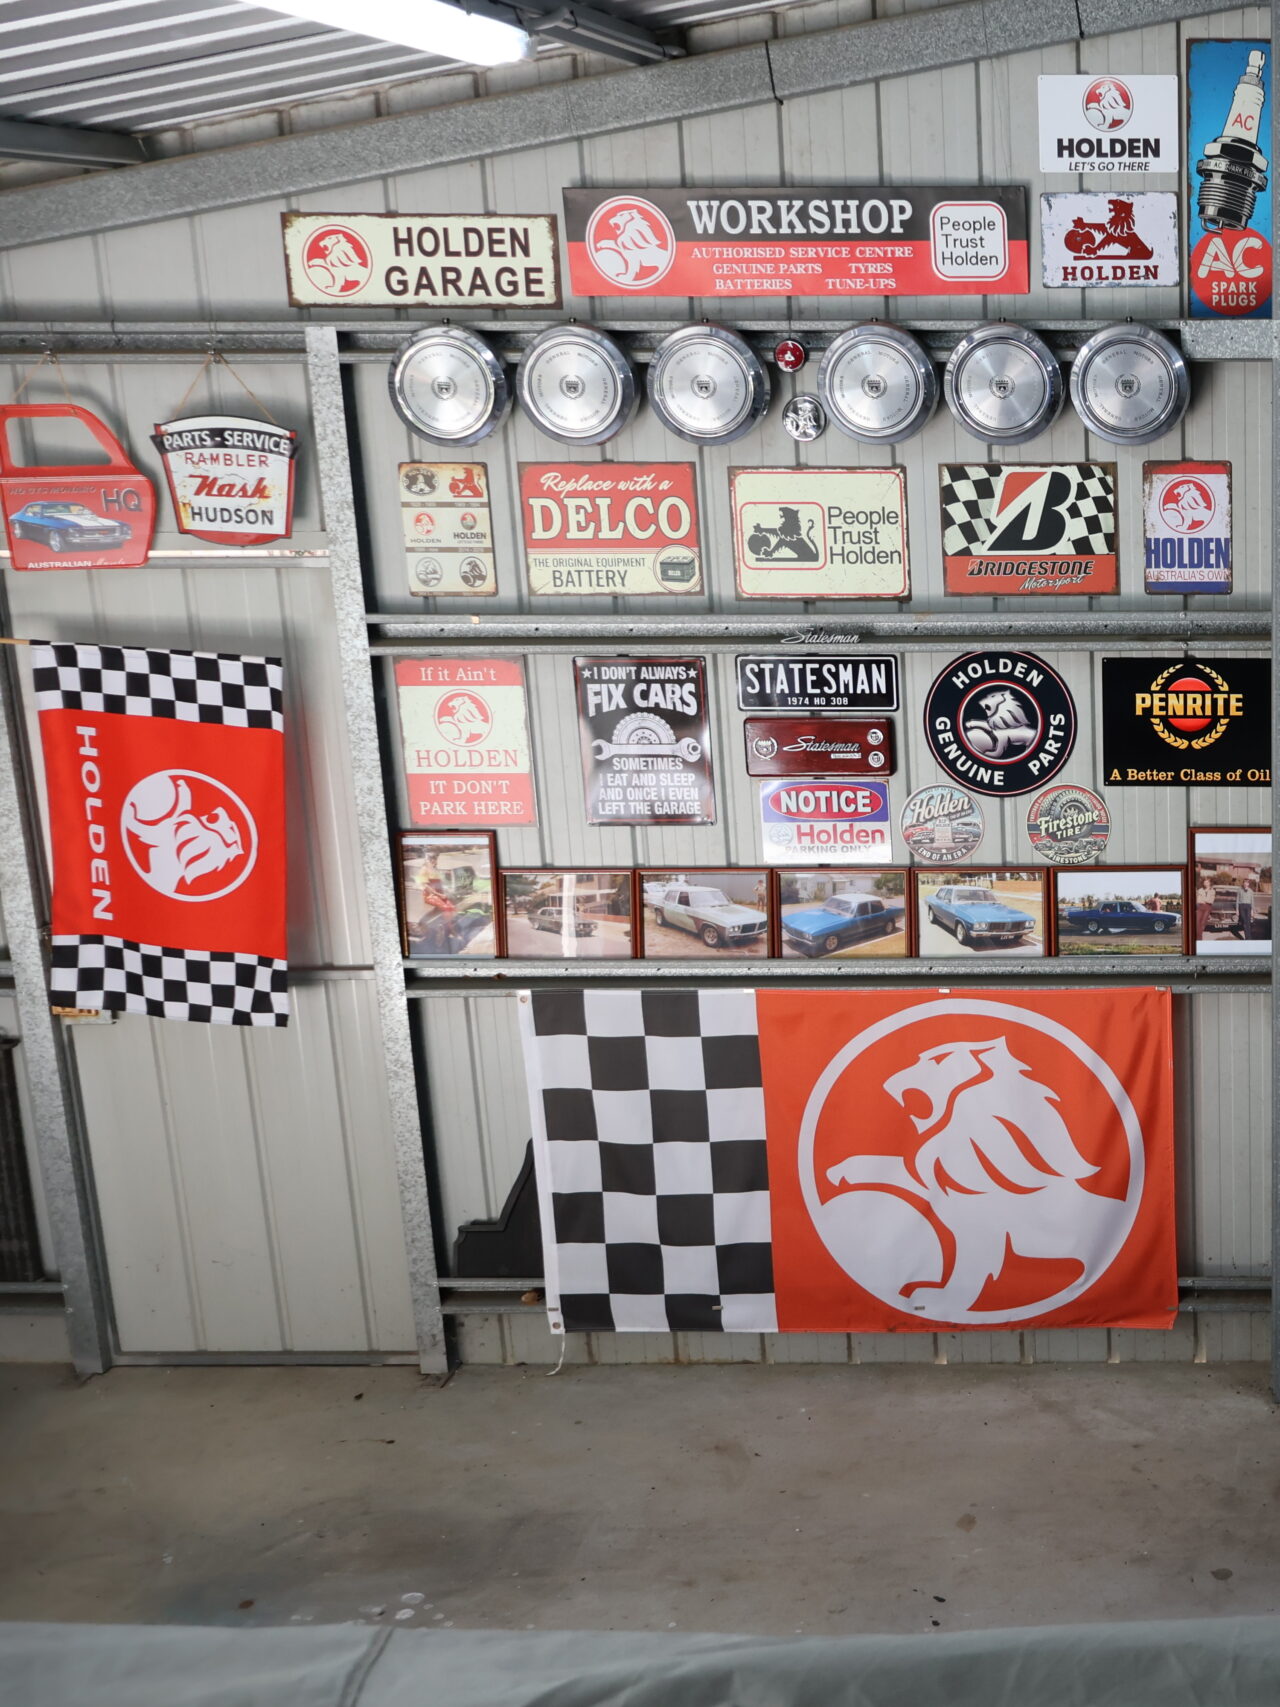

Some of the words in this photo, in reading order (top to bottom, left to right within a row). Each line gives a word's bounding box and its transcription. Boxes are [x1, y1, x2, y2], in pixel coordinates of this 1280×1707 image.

[1057, 138, 1160, 158] HOLDEN
[1069, 162, 1095, 171] LET'S
[1098, 162, 1114, 171] GO
[1117, 162, 1150, 171] THERE
[687, 199, 913, 234] WORKSHOP
[940, 216, 996, 234] People
[393, 226, 530, 257] HOLDEN
[941, 234, 985, 248] Trust
[692, 247, 785, 258] AUTHORISED
[789, 247, 850, 258] SERVICE
[855, 247, 913, 258] CENTRE
[941, 251, 999, 266] Holden
[1198, 237, 1264, 278] AC
[713, 264, 775, 274] GENUINE
[779, 264, 822, 274] PARTS
[849, 263, 893, 274] TYRES
[1062, 265, 1159, 281] HOLDEN
[385, 266, 545, 297] GARAGE
[715, 279, 792, 290] BATTERIES
[826, 278, 896, 289] TUNE-UPS
[1212, 281, 1257, 293] SPARK
[1212, 294, 1257, 306] PLUGS
[162, 431, 211, 451] PARTS
[225, 431, 290, 453] SERVICE
[185, 452, 269, 468] RAMBLER
[187, 474, 272, 499] Nash
[540, 472, 616, 498] Replace
[618, 474, 658, 491] with
[101, 488, 143, 512] HQ
[191, 506, 274, 525] HUDSON
[528, 496, 691, 540] DELCO
[828, 506, 898, 528] People
[827, 526, 880, 545] Trust
[829, 546, 902, 564] Holden
[1145, 537, 1229, 569] HOLDEN
[533, 558, 549, 568] THE
[552, 558, 593, 568] ORIGINAL
[596, 558, 645, 568] EQUIPMENT
[967, 559, 1095, 577] BRIDGESTONE
[552, 570, 627, 587] BATTERY
[1019, 574, 1087, 591] Motorsport
[1147, 570, 1205, 581] AUSTRALIA'S
[780, 627, 861, 644] Statesman
[456, 667, 496, 681] Ain't
[601, 667, 637, 680] DON'T
[641, 667, 687, 679] ALWAYS
[745, 663, 887, 694] STATESMAN
[952, 658, 1044, 689] HOLDEN
[586, 683, 627, 717] FIX
[633, 683, 698, 716] CARS
[1135, 693, 1244, 716] PENRITE
[783, 735, 860, 752] Statesman
[935, 716, 1004, 785] GENUINE
[1028, 713, 1065, 776] PARTS
[415, 750, 518, 767] HOLDEN
[612, 757, 684, 770] SOMETIMES
[607, 773, 628, 786] EAT
[632, 773, 656, 786] AND
[660, 773, 696, 786] SLEEP
[1126, 769, 1175, 781] Better
[1180, 769, 1221, 781] Class
[1247, 769, 1271, 781] Oil
[453, 780, 510, 794] DON'T
[599, 788, 623, 800] AND
[627, 788, 657, 800] ONCE
[669, 788, 699, 800] EVEN
[420, 802, 467, 815] PARK
[474, 802, 524, 815] HERE
[599, 802, 626, 815] LEFT
[629, 802, 651, 815] THE
[654, 801, 701, 815] GARAGE
[779, 790, 872, 813] NOTICE
[910, 792, 972, 824] Holden
[76, 725, 113, 920] HOLDEN
[1037, 810, 1099, 837] Firestone
[796, 823, 885, 845] Holden
[1056, 826, 1081, 839] TIRE
[918, 847, 931, 858] END
[953, 848, 967, 858] ERA
